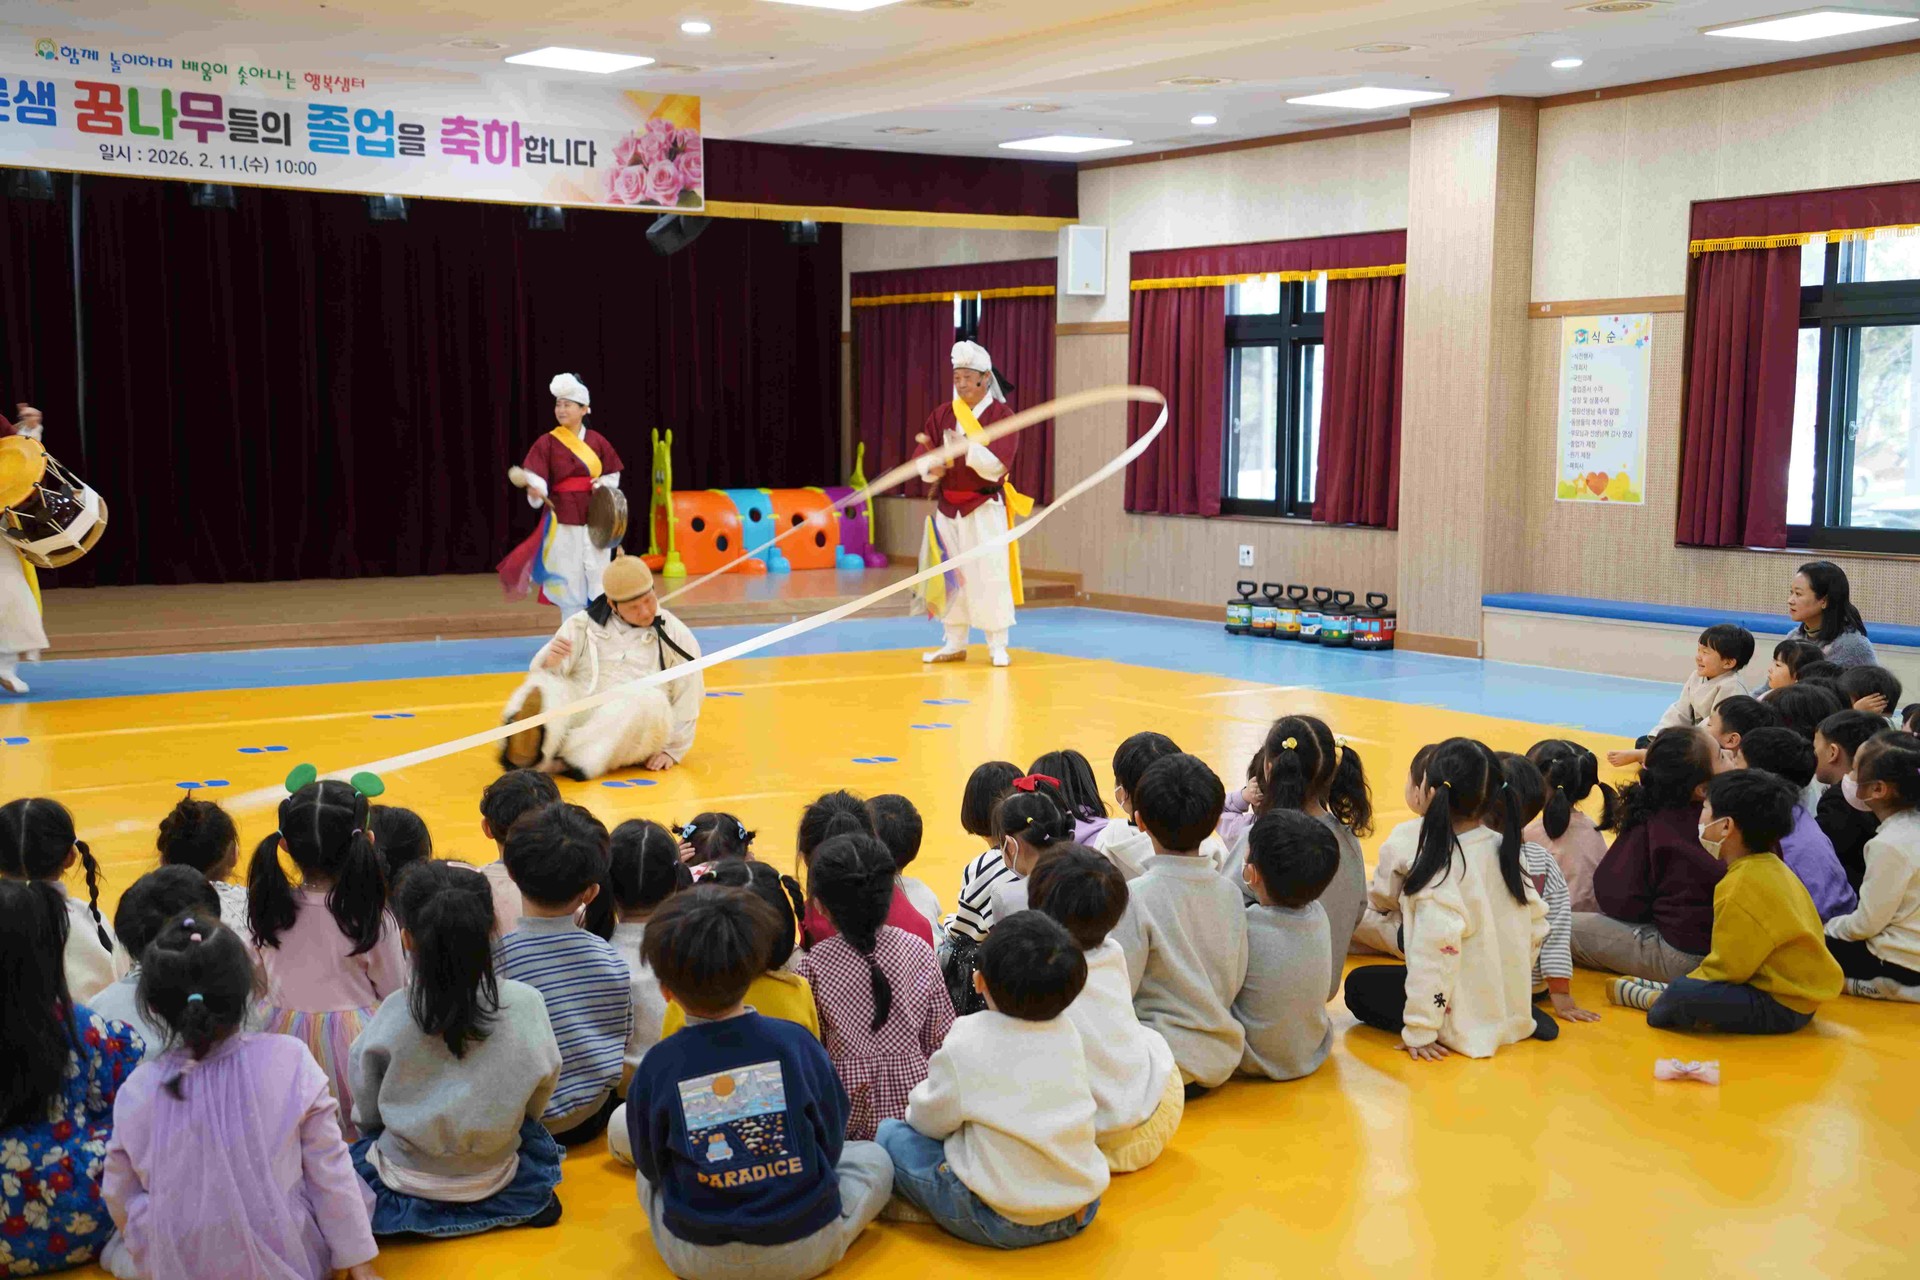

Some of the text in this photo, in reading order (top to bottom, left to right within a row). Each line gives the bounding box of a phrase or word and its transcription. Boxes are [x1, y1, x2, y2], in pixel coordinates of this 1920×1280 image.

[60, 46, 366, 94] 함께 놀이하며 배움이 솟아나는 행복샘터
[74, 80, 292, 146] 꿈나무들의
[307, 103, 426, 158] 졸업을
[440, 115, 597, 168] 축하합니다
[98, 143, 131, 163] 일시
[148, 148, 194, 167] 2026.
[199, 152, 213, 169] 2.
[219, 154, 269, 174] 11.(수)
[276, 159, 317, 176] 10:00
